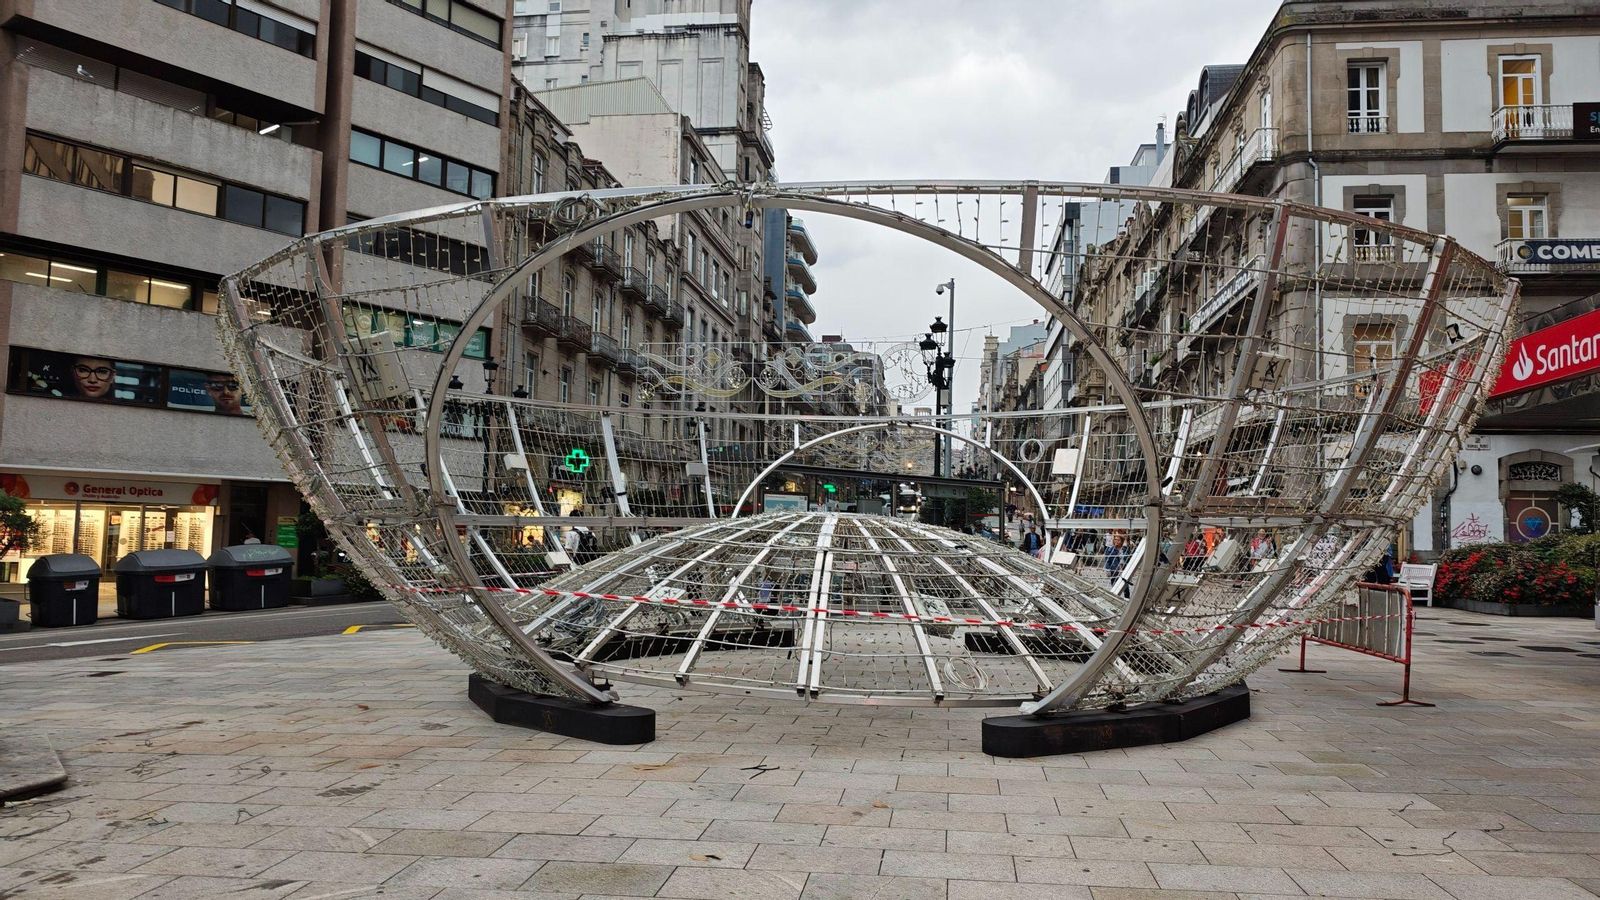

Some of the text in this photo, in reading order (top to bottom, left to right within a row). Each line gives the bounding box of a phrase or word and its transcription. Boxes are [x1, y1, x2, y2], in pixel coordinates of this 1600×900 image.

[172, 386, 207, 395] POLICE
[83, 484, 126, 495] General
[129, 486, 163, 497] Optica
